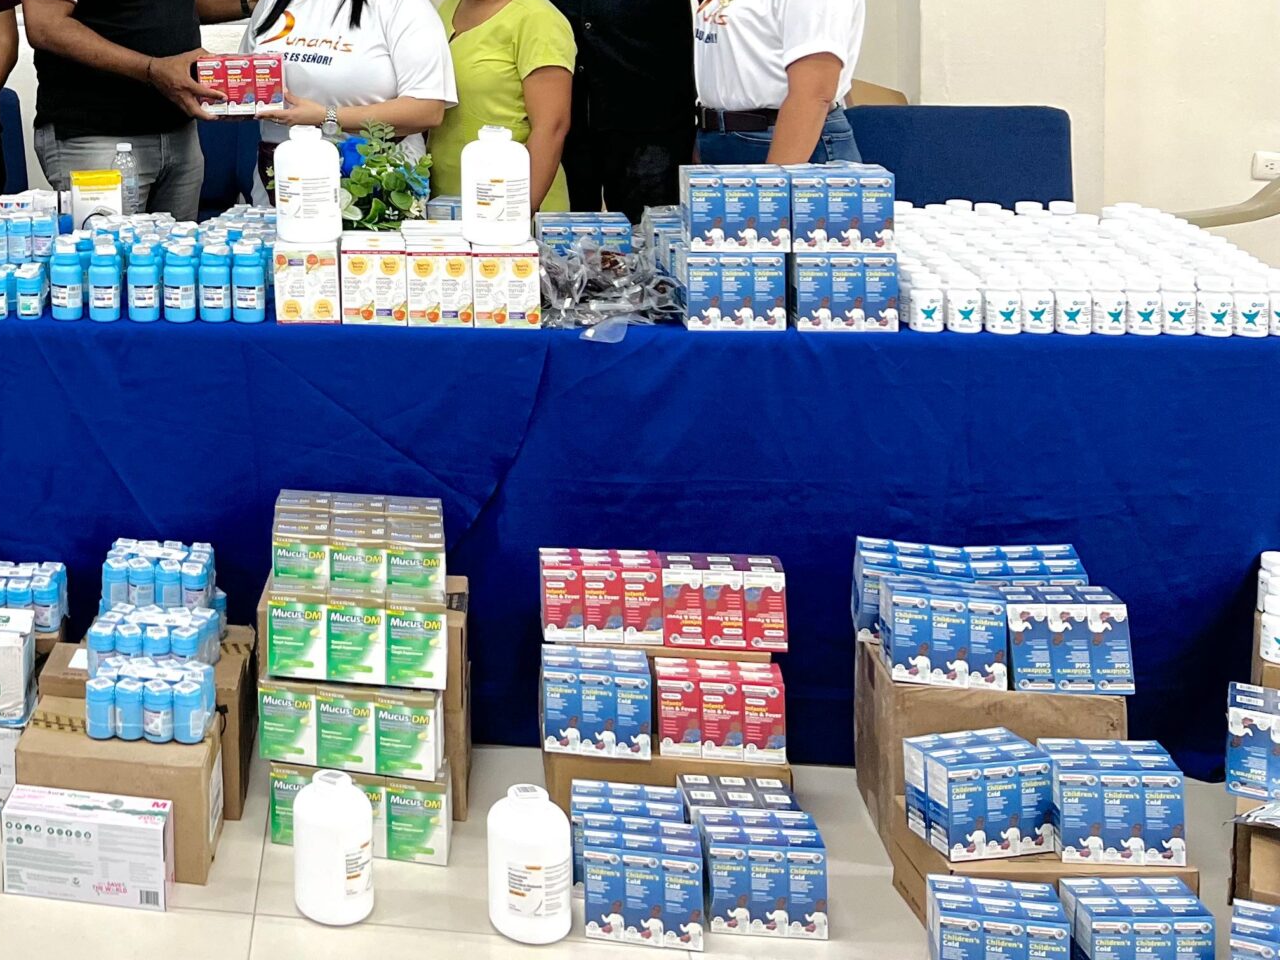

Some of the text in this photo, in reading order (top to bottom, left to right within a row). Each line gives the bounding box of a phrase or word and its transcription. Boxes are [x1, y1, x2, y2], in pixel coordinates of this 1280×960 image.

[290, 53, 300, 61] ES
[302, 53, 332, 65] SEÑOR!
[277, 549, 326, 560] Mucus DM
[333, 552, 383, 564] Mucus DM
[390, 557, 440, 567] Mucus DM
[272, 609, 321, 620] Mucus DM
[331, 613, 381, 625] Mucus DM
[390, 618, 441, 630] Mucus DM
[262, 695, 311, 710] Mucus DM
[320, 704, 370, 717] Mucus DM
[378, 710, 430, 725] Mucus DM
[390, 795, 442, 809] Mucus DM
[943, 934, 980, 944] Children's
[943, 940, 959, 948] Cold
[986, 939, 1023, 949] Children's
[1029, 943, 1066, 952] Children's
